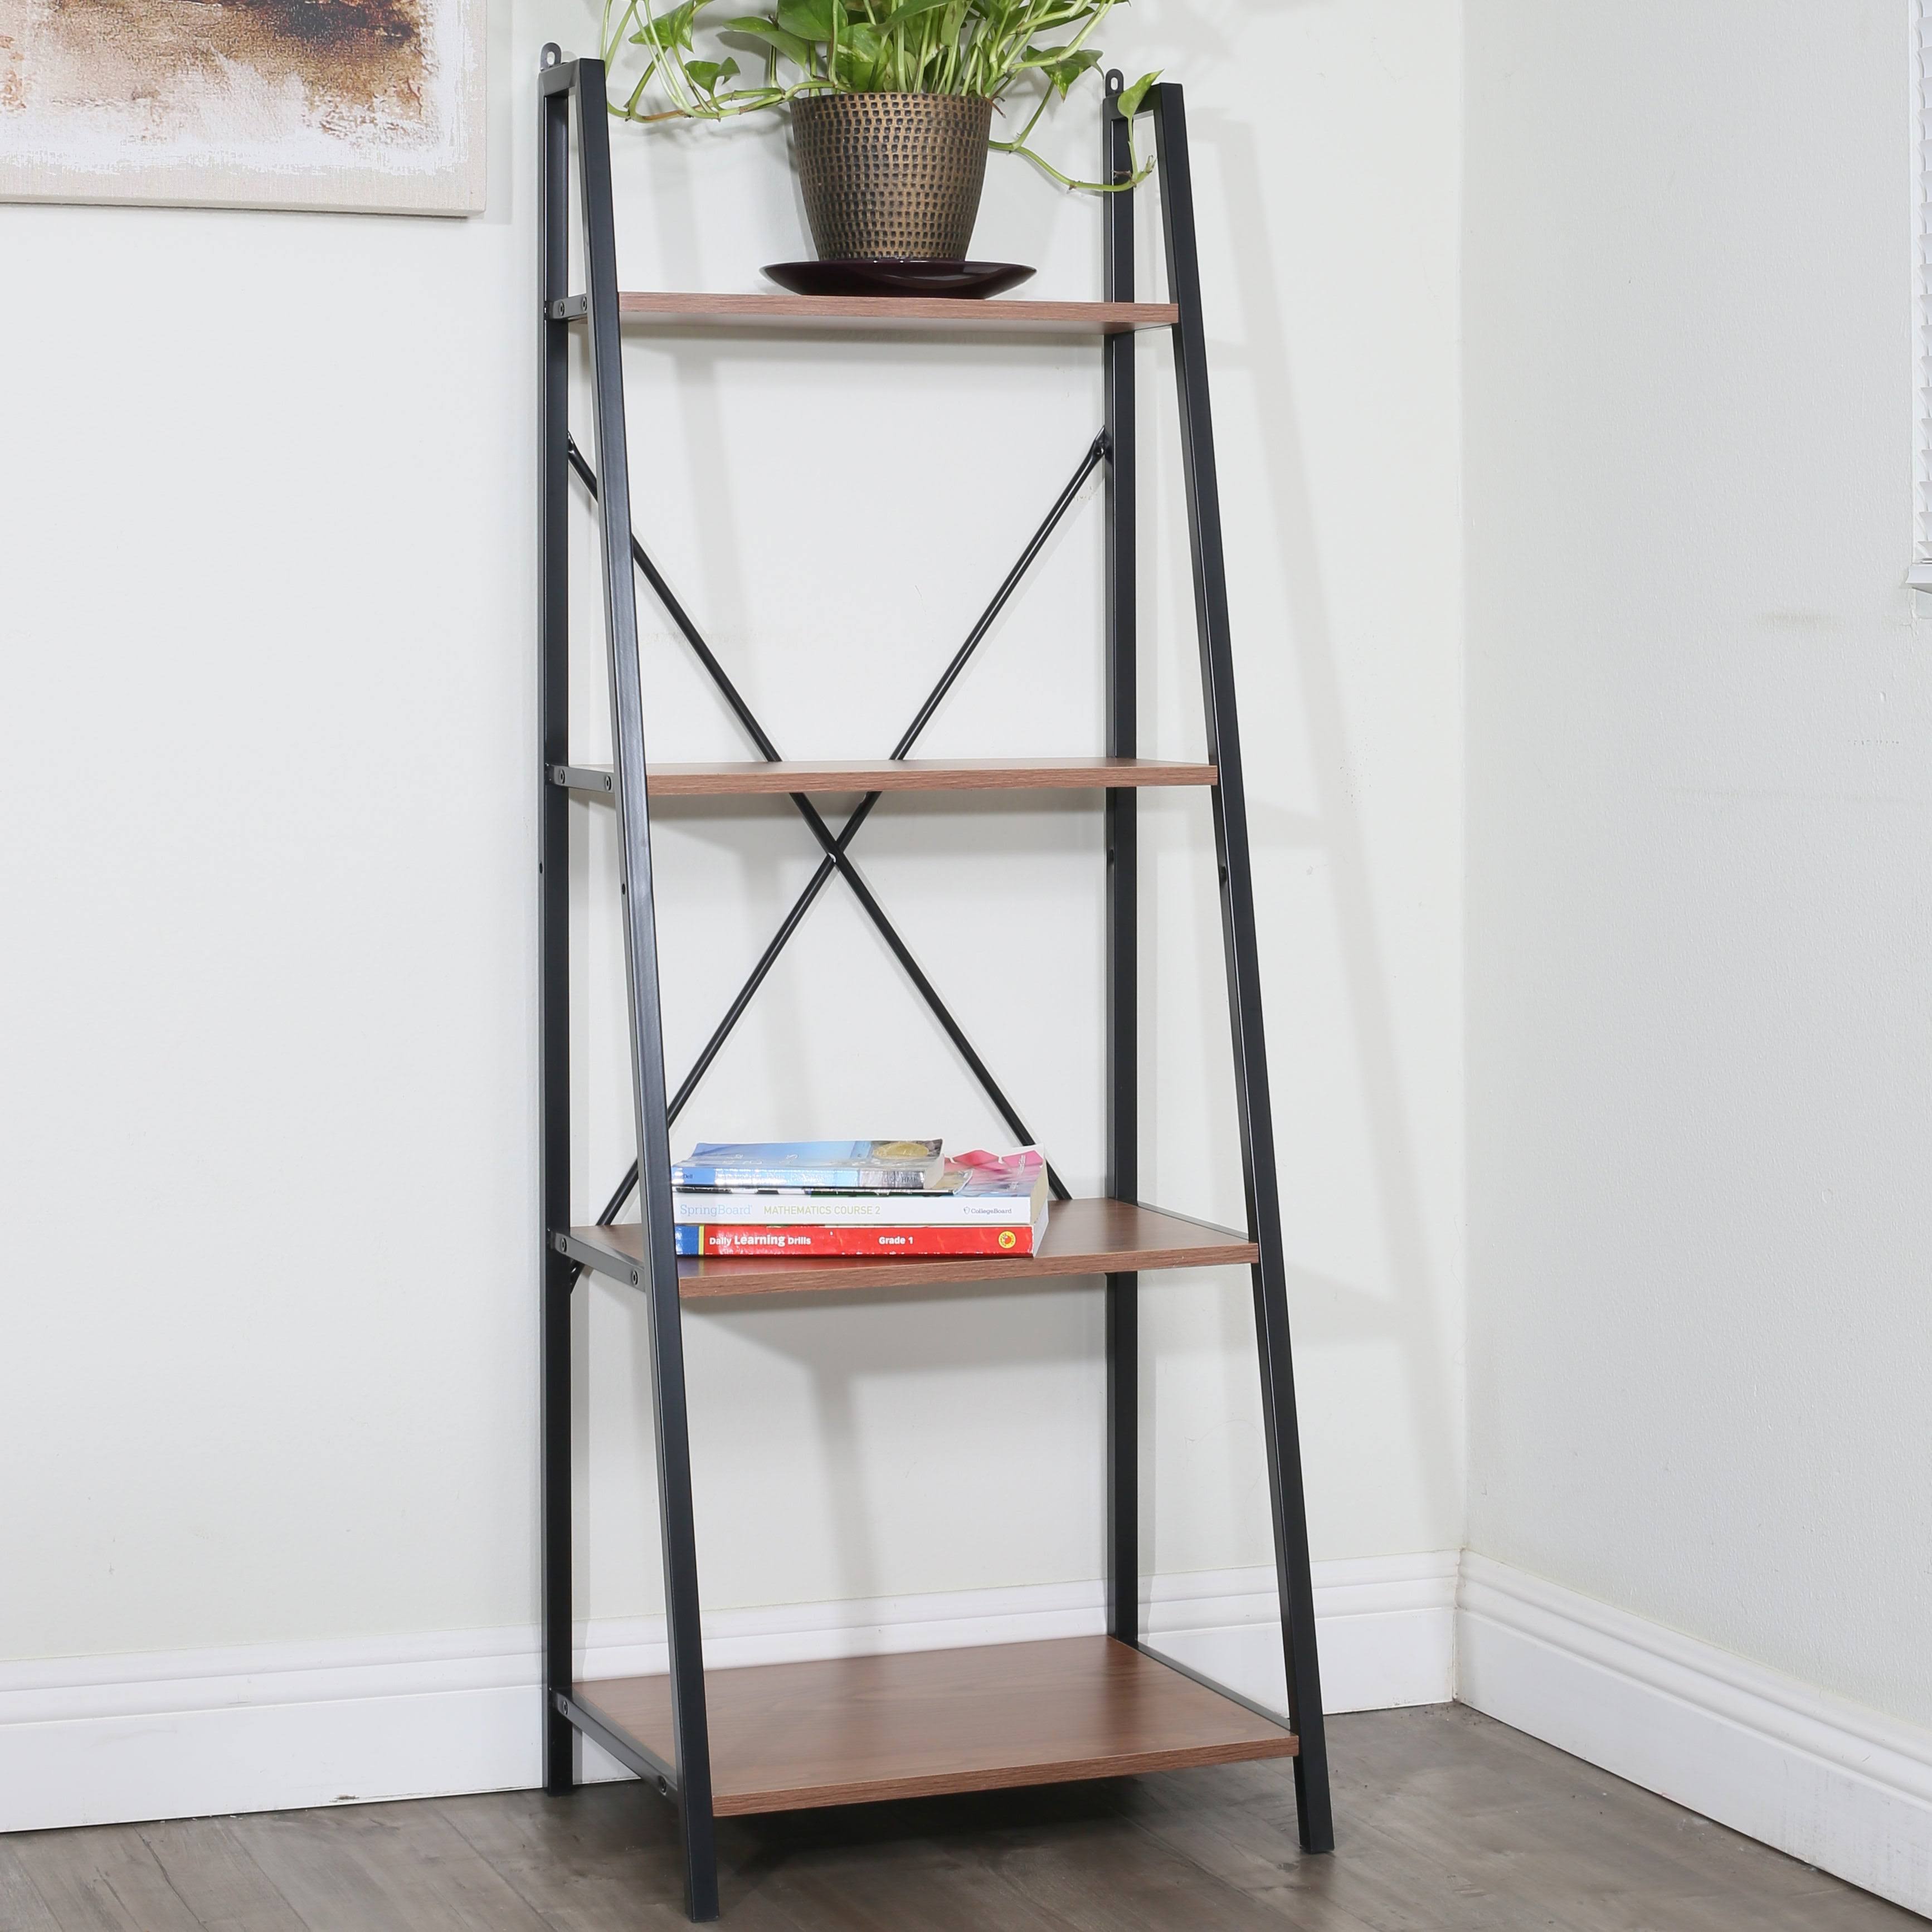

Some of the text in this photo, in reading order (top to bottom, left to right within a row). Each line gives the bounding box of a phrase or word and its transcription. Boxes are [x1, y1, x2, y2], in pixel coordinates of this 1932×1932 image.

[680, 1204, 880, 1217] SpringBoard MATHEMATICS COURSE 2
[709, 1235, 811, 1247] Daily Learning Drills
